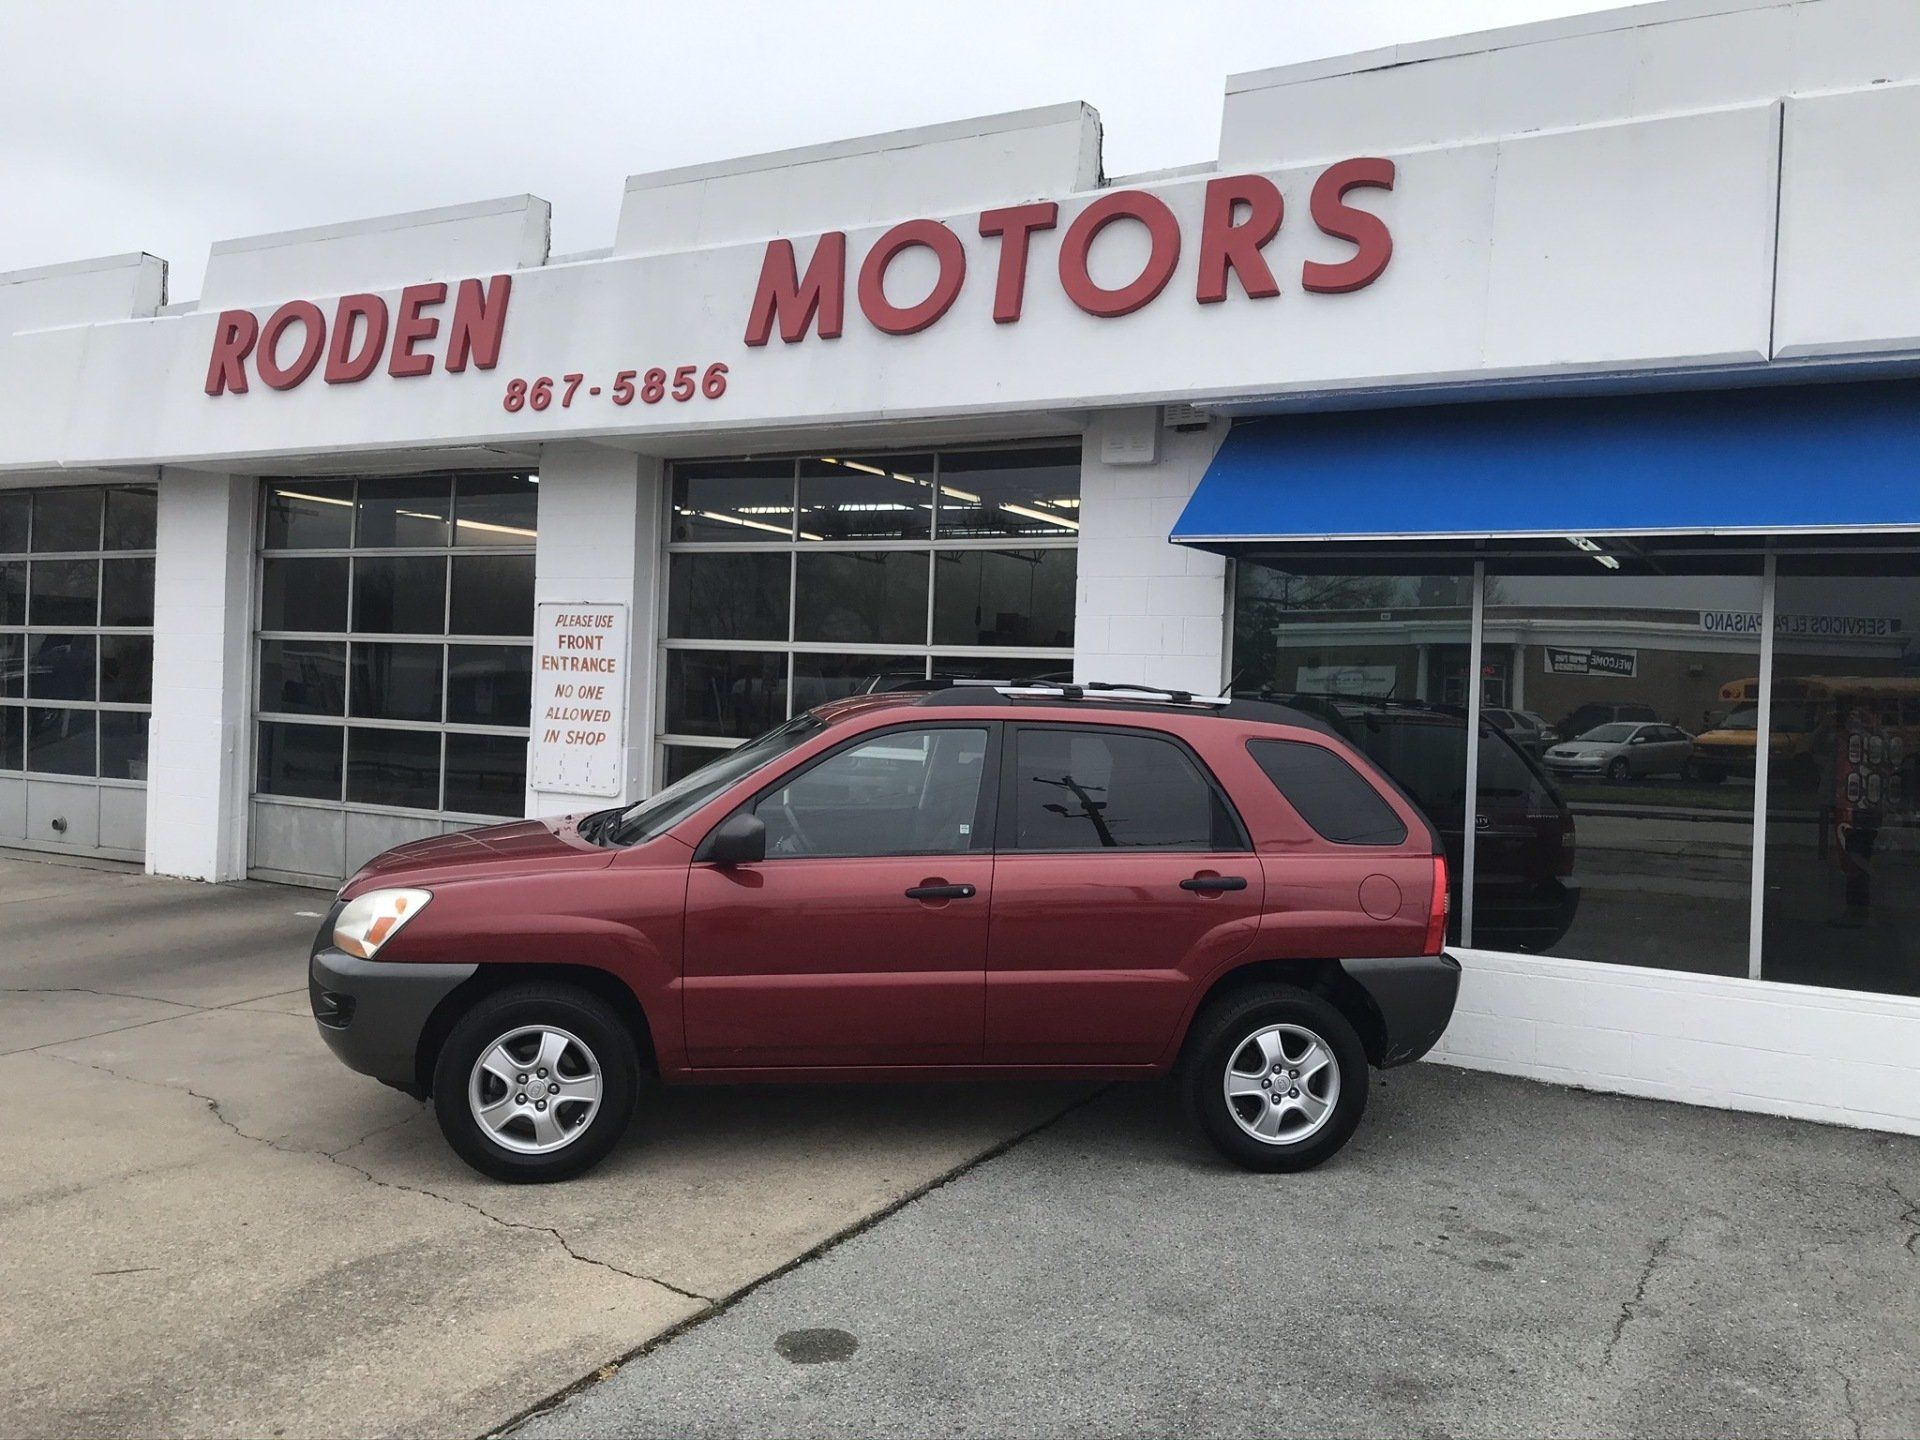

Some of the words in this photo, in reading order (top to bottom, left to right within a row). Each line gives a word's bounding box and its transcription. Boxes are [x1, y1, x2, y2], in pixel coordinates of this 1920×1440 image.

[204, 274, 512, 396] RODEN
[744, 157, 1395, 347] MOTORS
[502, 362, 729, 412] 867-5856
[555, 614, 594, 628] PLEASE
[594, 615, 614, 628] USE
[558, 634, 604, 651] FRONT
[541, 655, 616, 673] ENTRANCE
[555, 684, 573, 698] NO
[578, 685, 604, 700] ONE
[545, 707, 611, 722] ALLOWED
[543, 729, 560, 743] IN
[565, 730, 606, 746] SHOP
